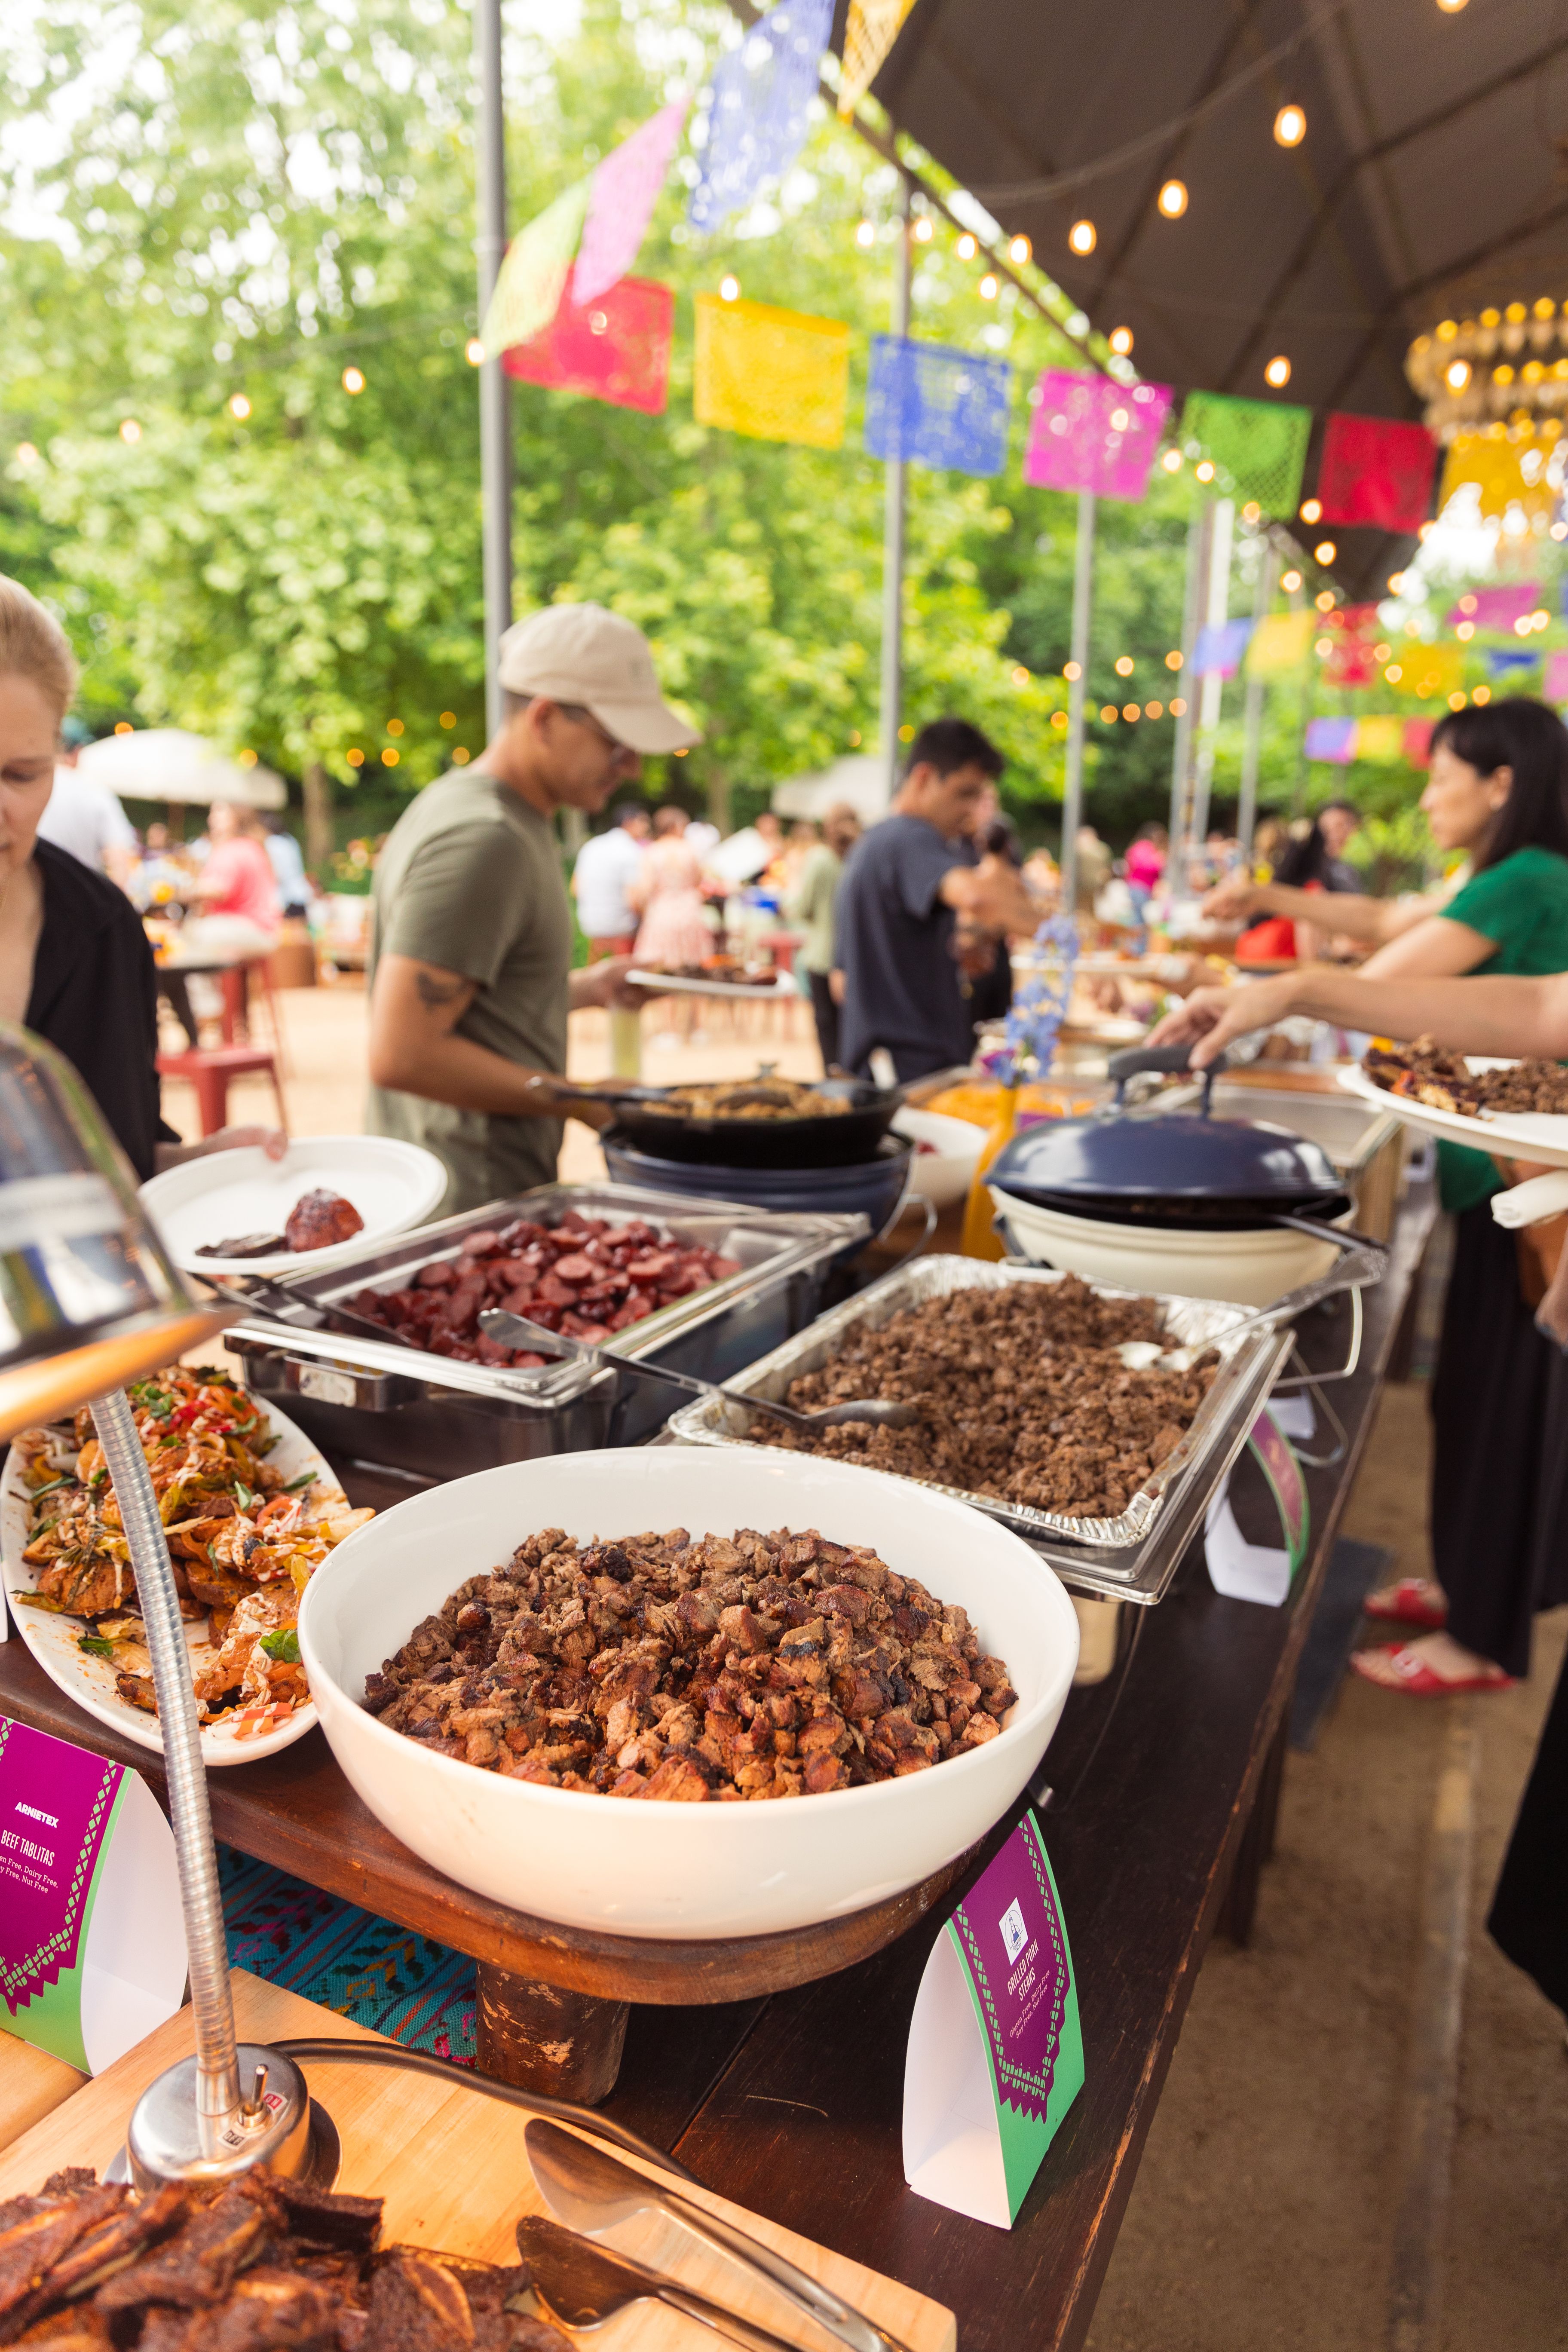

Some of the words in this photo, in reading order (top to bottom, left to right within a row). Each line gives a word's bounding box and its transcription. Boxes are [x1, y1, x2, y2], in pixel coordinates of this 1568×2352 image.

[15, 1802, 59, 1828] ARNIETEX
[1, 1829, 20, 1850] BEEF
[20, 1838, 55, 1866] TABLITAS
[5, 1867, 20, 1881] Free,
[22, 1875, 33, 1886] Nut
[34, 1881, 48, 1893] Free
[8, 1858, 22, 1871] Free,
[24, 1865, 42, 1880] Dairy
[43, 1874, 58, 1888] Free,
[1007, 1959, 1027, 1995] GRILLED
[1026, 1939, 1039, 1967] PORK
[1018, 1967, 1036, 2001] STEAKS
[1010, 2016, 1023, 2037] Gluten
[1031, 1983, 1042, 2002] Dairy
[1016, 2024, 1024, 2039] Soy
[1039, 1984, 1048, 1999] Free
[266, 2095, 280, 2106] ON
[224, 2131, 243, 2144] OFF
